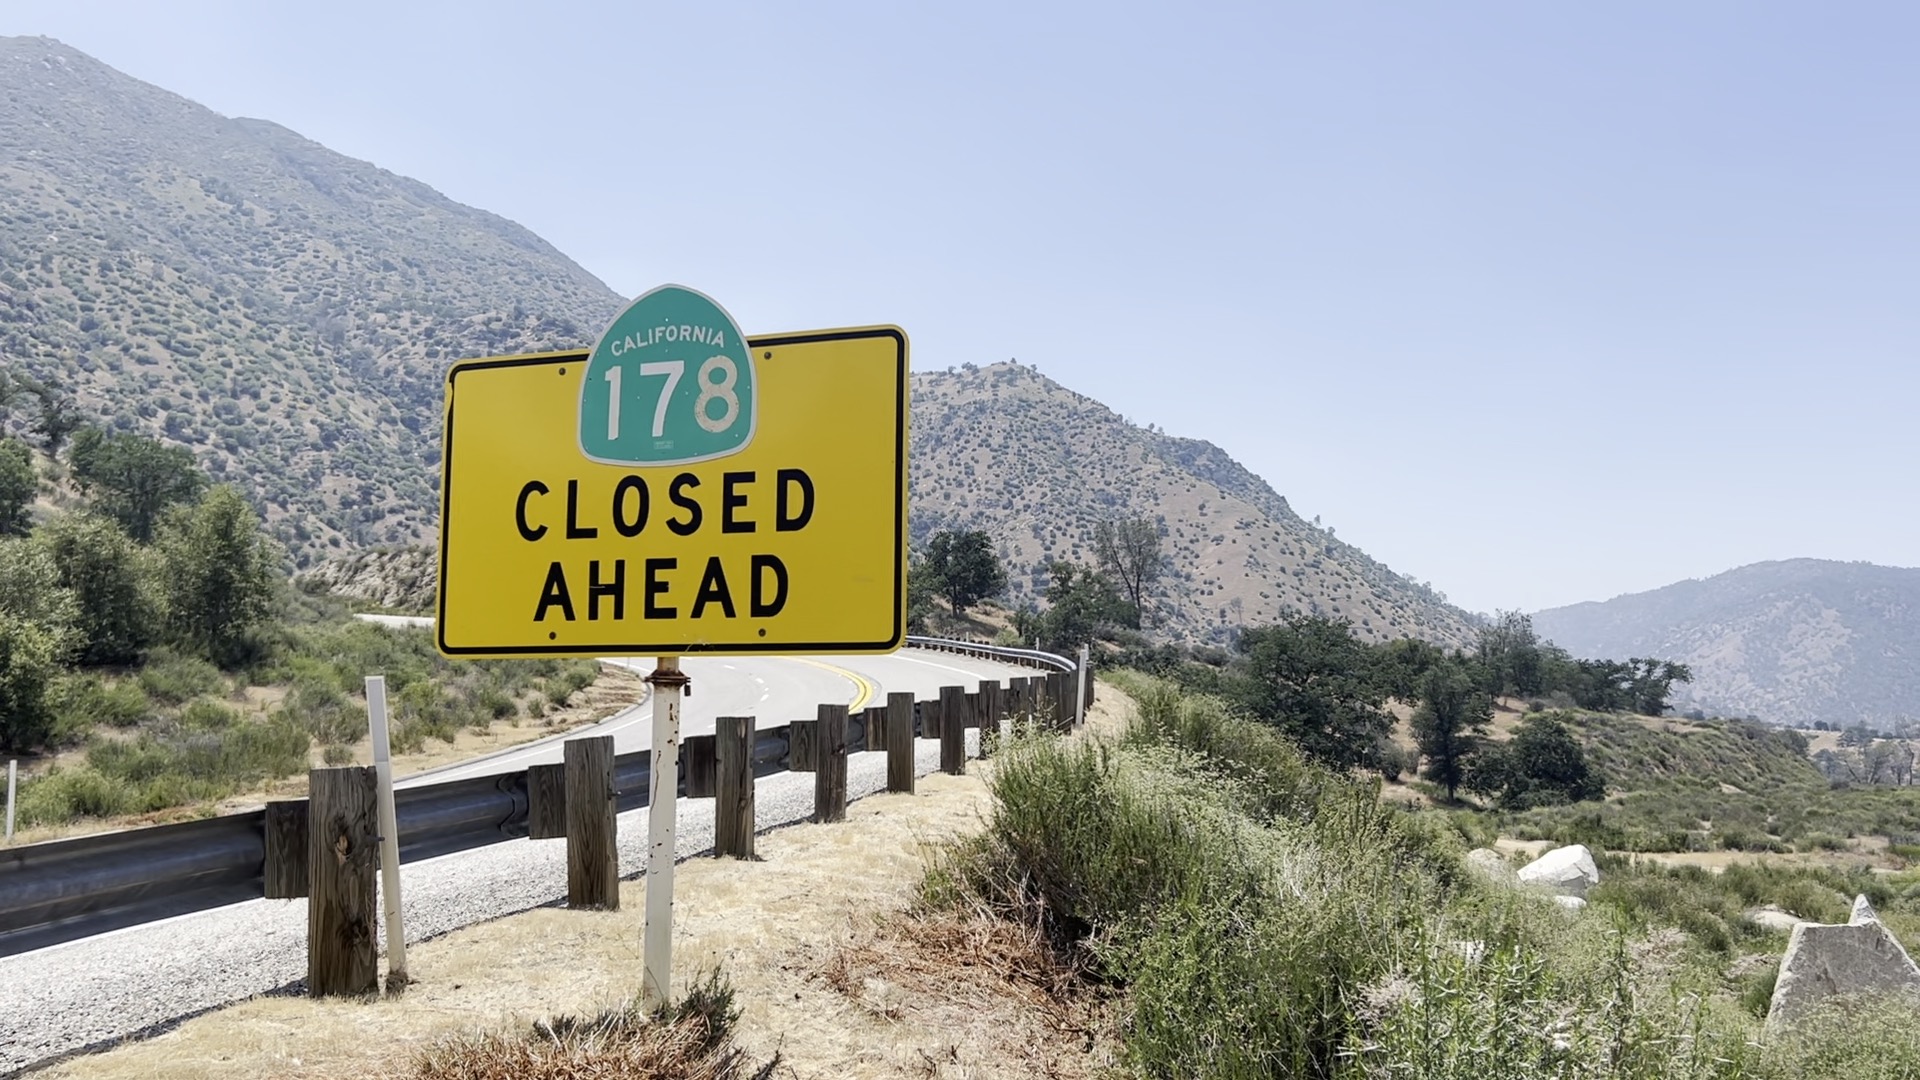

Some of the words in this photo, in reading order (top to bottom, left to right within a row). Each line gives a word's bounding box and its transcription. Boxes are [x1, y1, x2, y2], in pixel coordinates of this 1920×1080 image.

[611, 325, 724, 356] CALIFORNIA
[604, 355, 740, 441] 178
[515, 468, 815, 542] CLOSED
[533, 554, 789, 622] AHEAD
